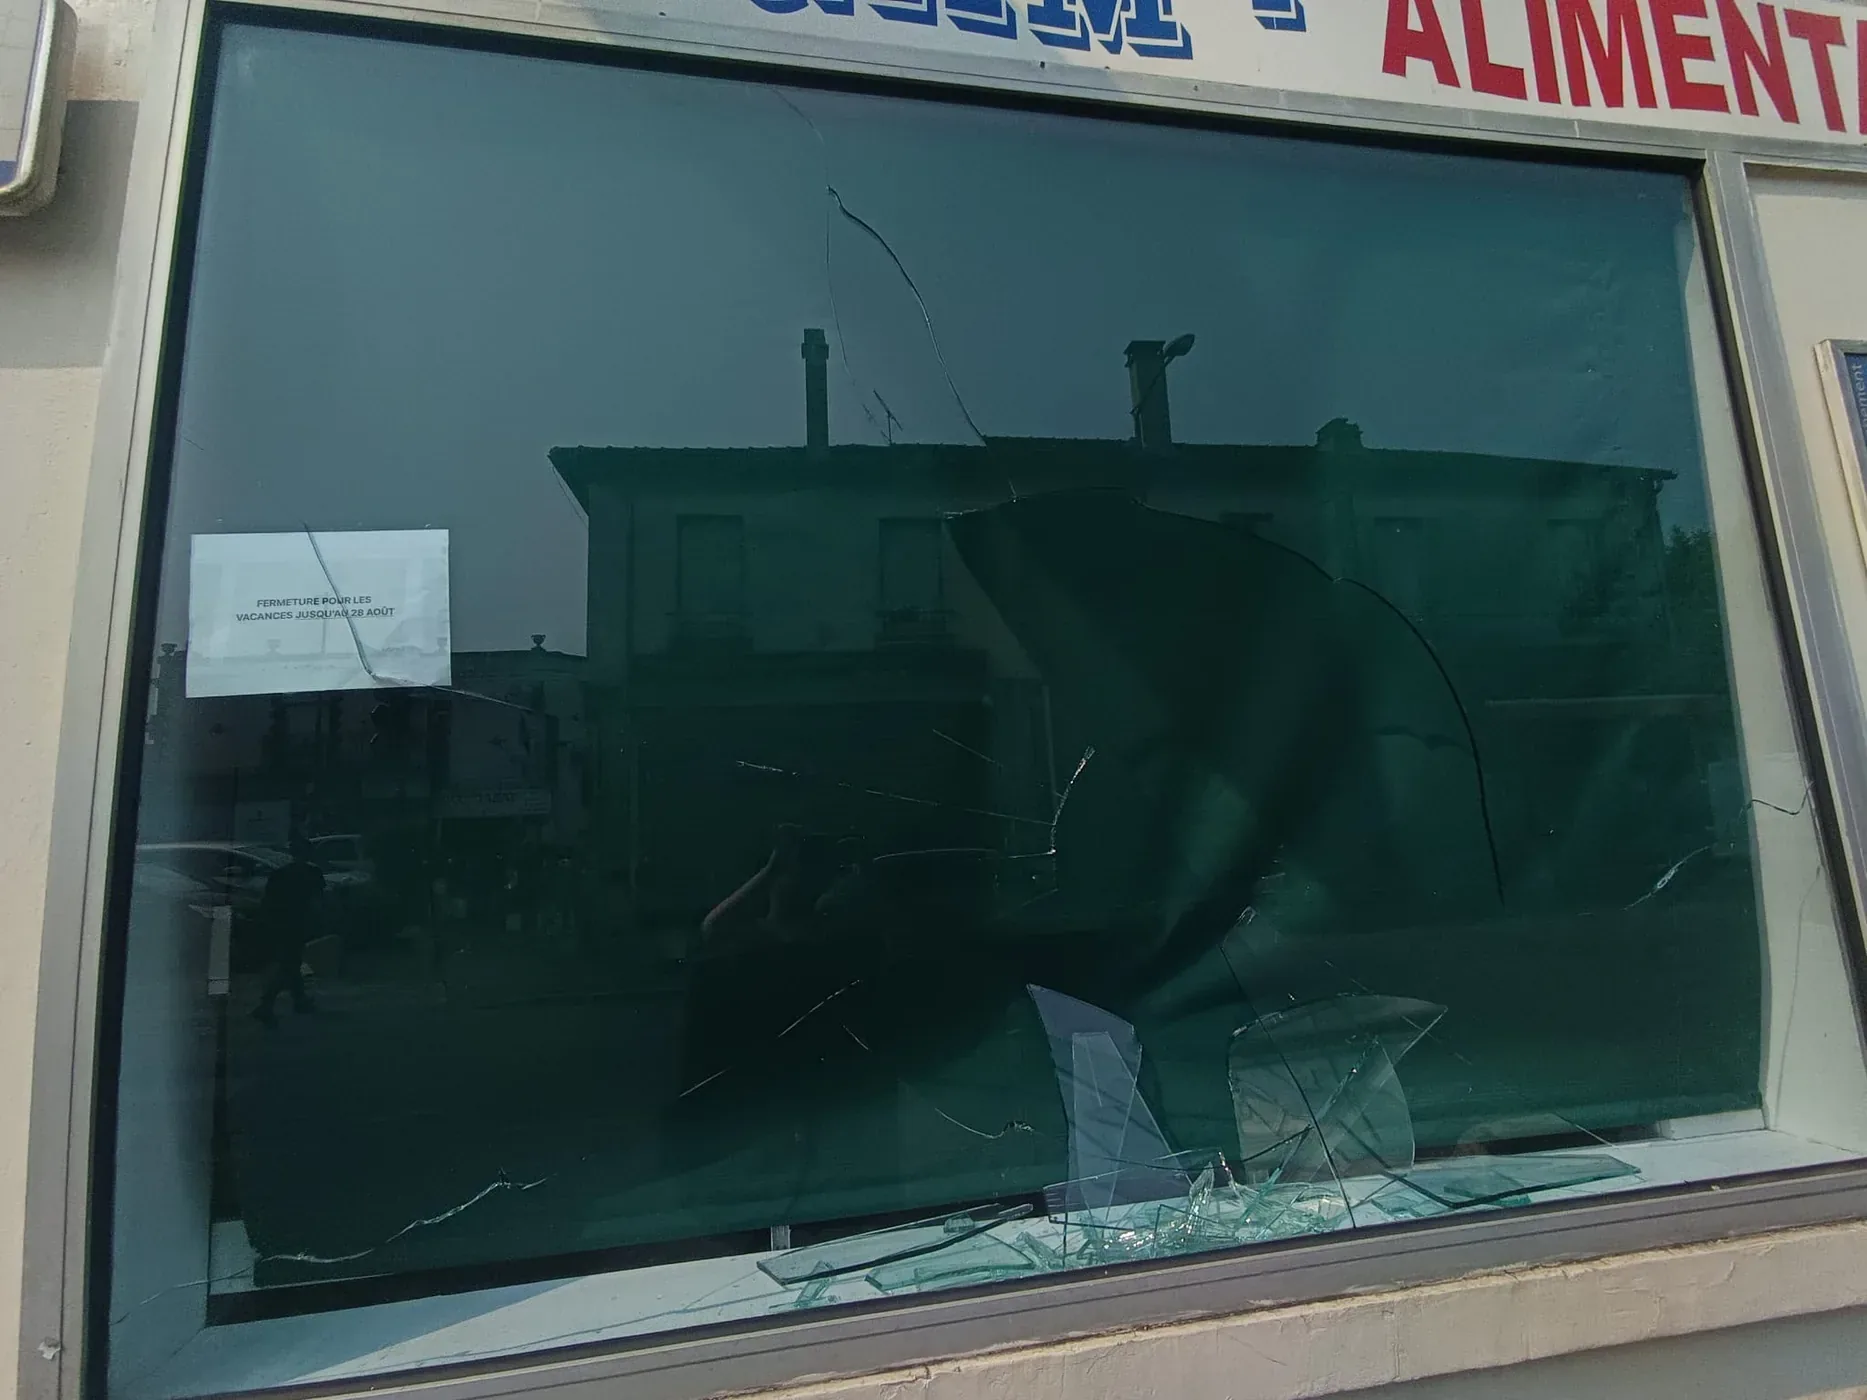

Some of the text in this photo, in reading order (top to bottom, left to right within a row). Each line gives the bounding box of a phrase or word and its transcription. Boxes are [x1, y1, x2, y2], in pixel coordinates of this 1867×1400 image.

[1382, 0, 1867, 135] ALIMENT
[257, 595, 372, 607] FERMETURE POUR LES
[236, 606, 395, 621] VACANCES JUSQU'AU 28 AOÛT
